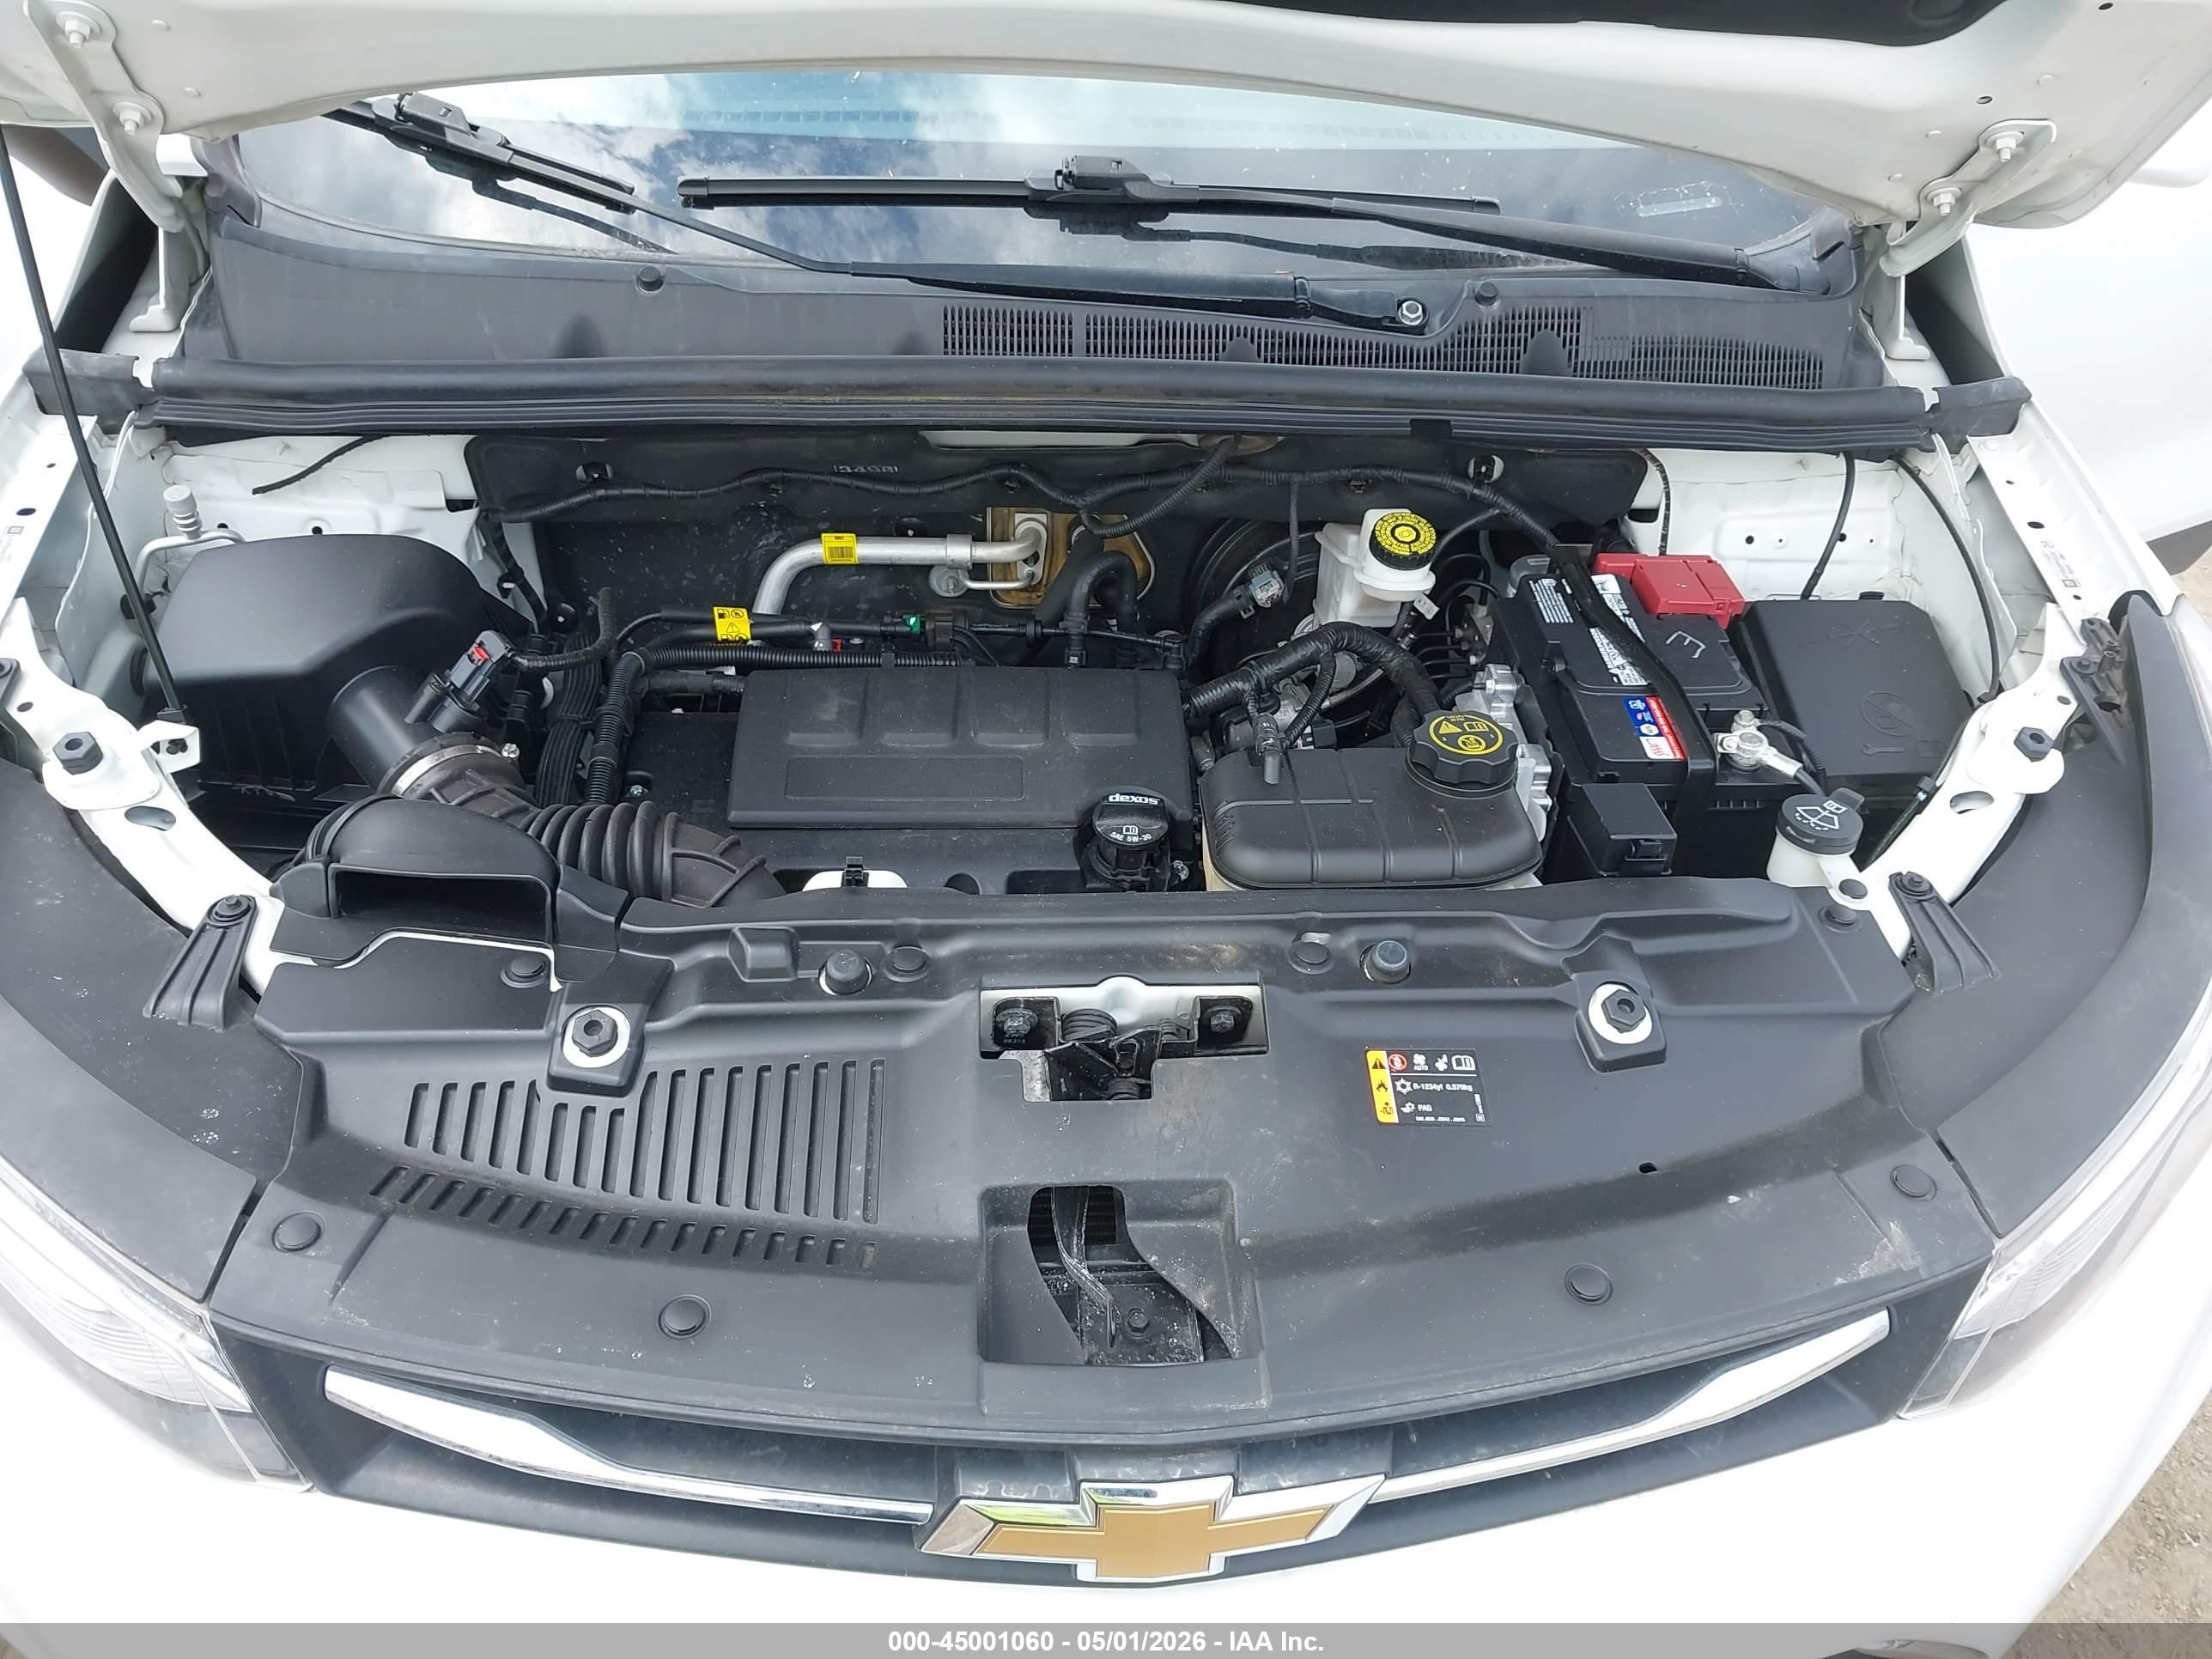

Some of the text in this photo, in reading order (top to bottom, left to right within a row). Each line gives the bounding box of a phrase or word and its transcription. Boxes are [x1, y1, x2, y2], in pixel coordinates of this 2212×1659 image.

[1109, 793, 1160, 805] dexos
[1110, 831, 1152, 842] SAE 5W-30
